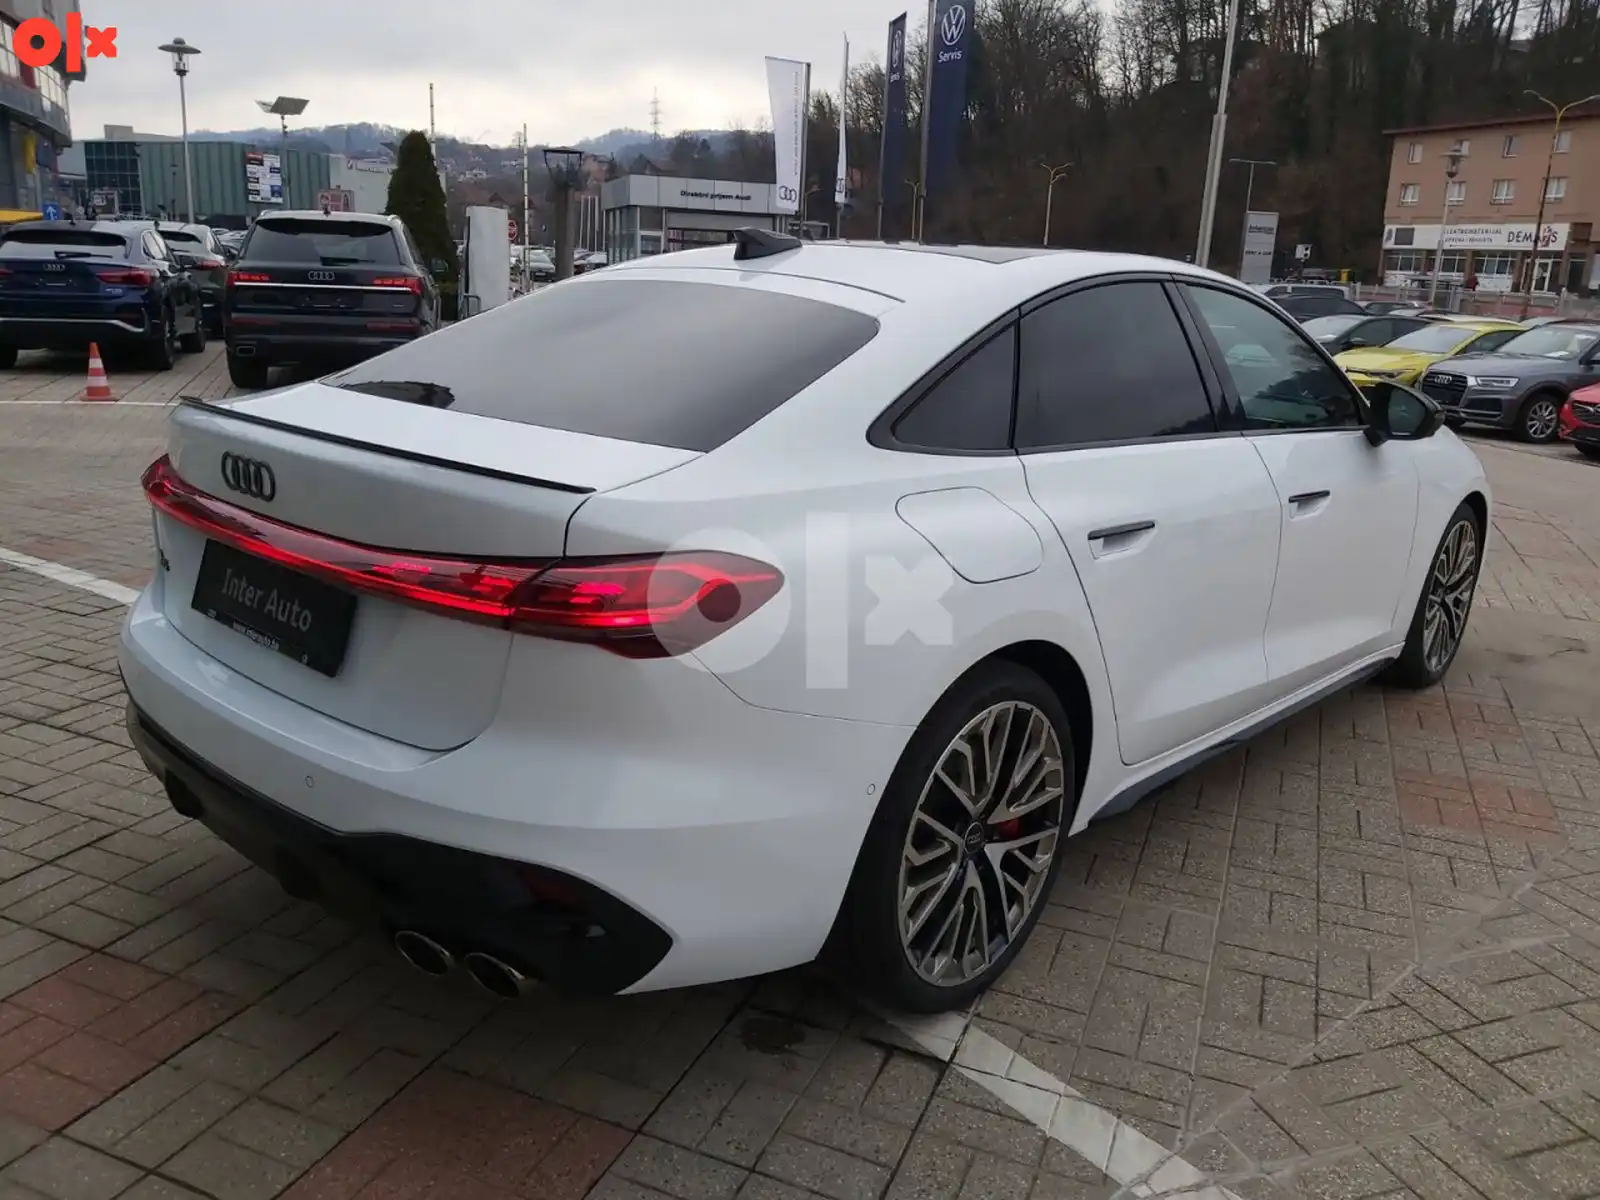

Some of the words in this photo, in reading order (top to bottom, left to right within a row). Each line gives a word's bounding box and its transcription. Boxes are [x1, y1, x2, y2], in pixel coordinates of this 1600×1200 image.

[938, 48, 963, 63] Servis
[221, 567, 264, 610] Inter
[264, 587, 312, 632] Auto
